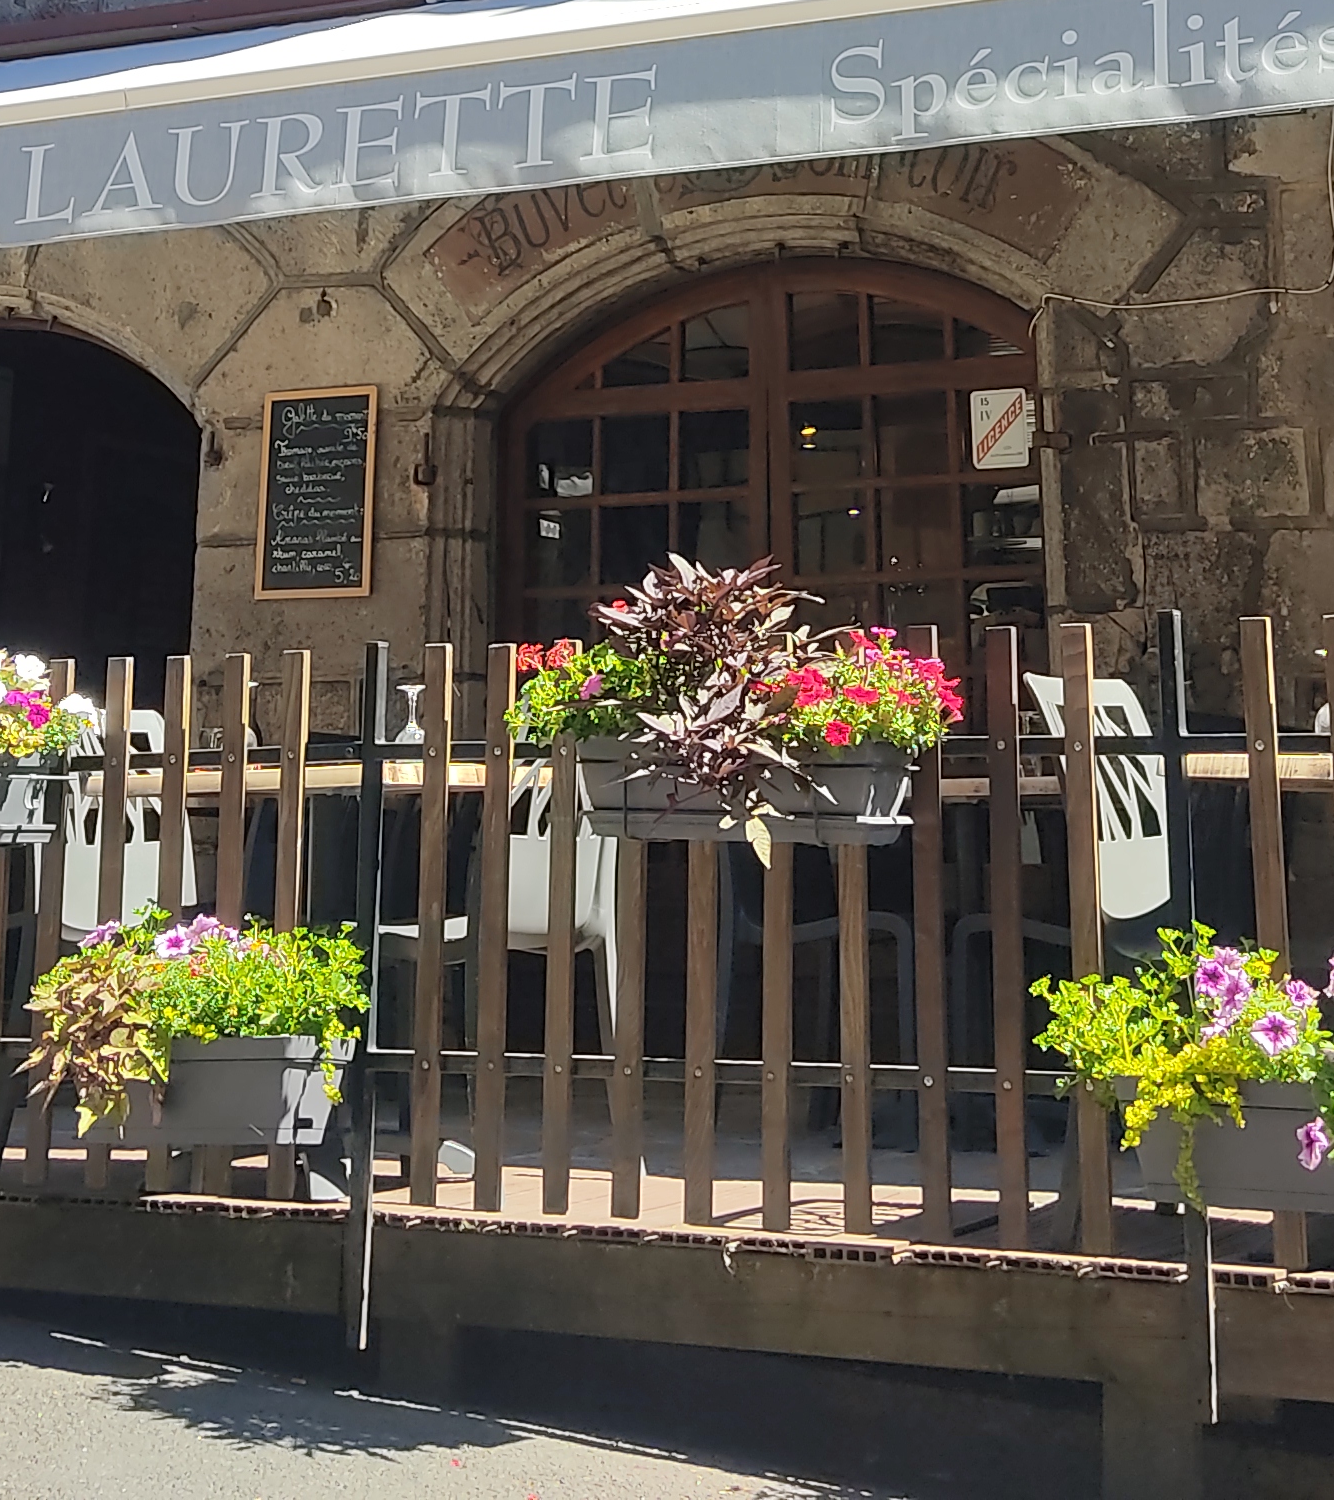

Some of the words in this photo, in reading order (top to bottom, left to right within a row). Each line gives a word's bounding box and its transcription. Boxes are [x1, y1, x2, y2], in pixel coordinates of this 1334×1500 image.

[12, 64, 659, 226] LAURETTE
[978, 395, 1022, 460] LICENCE
[980, 410, 992, 421] IV
